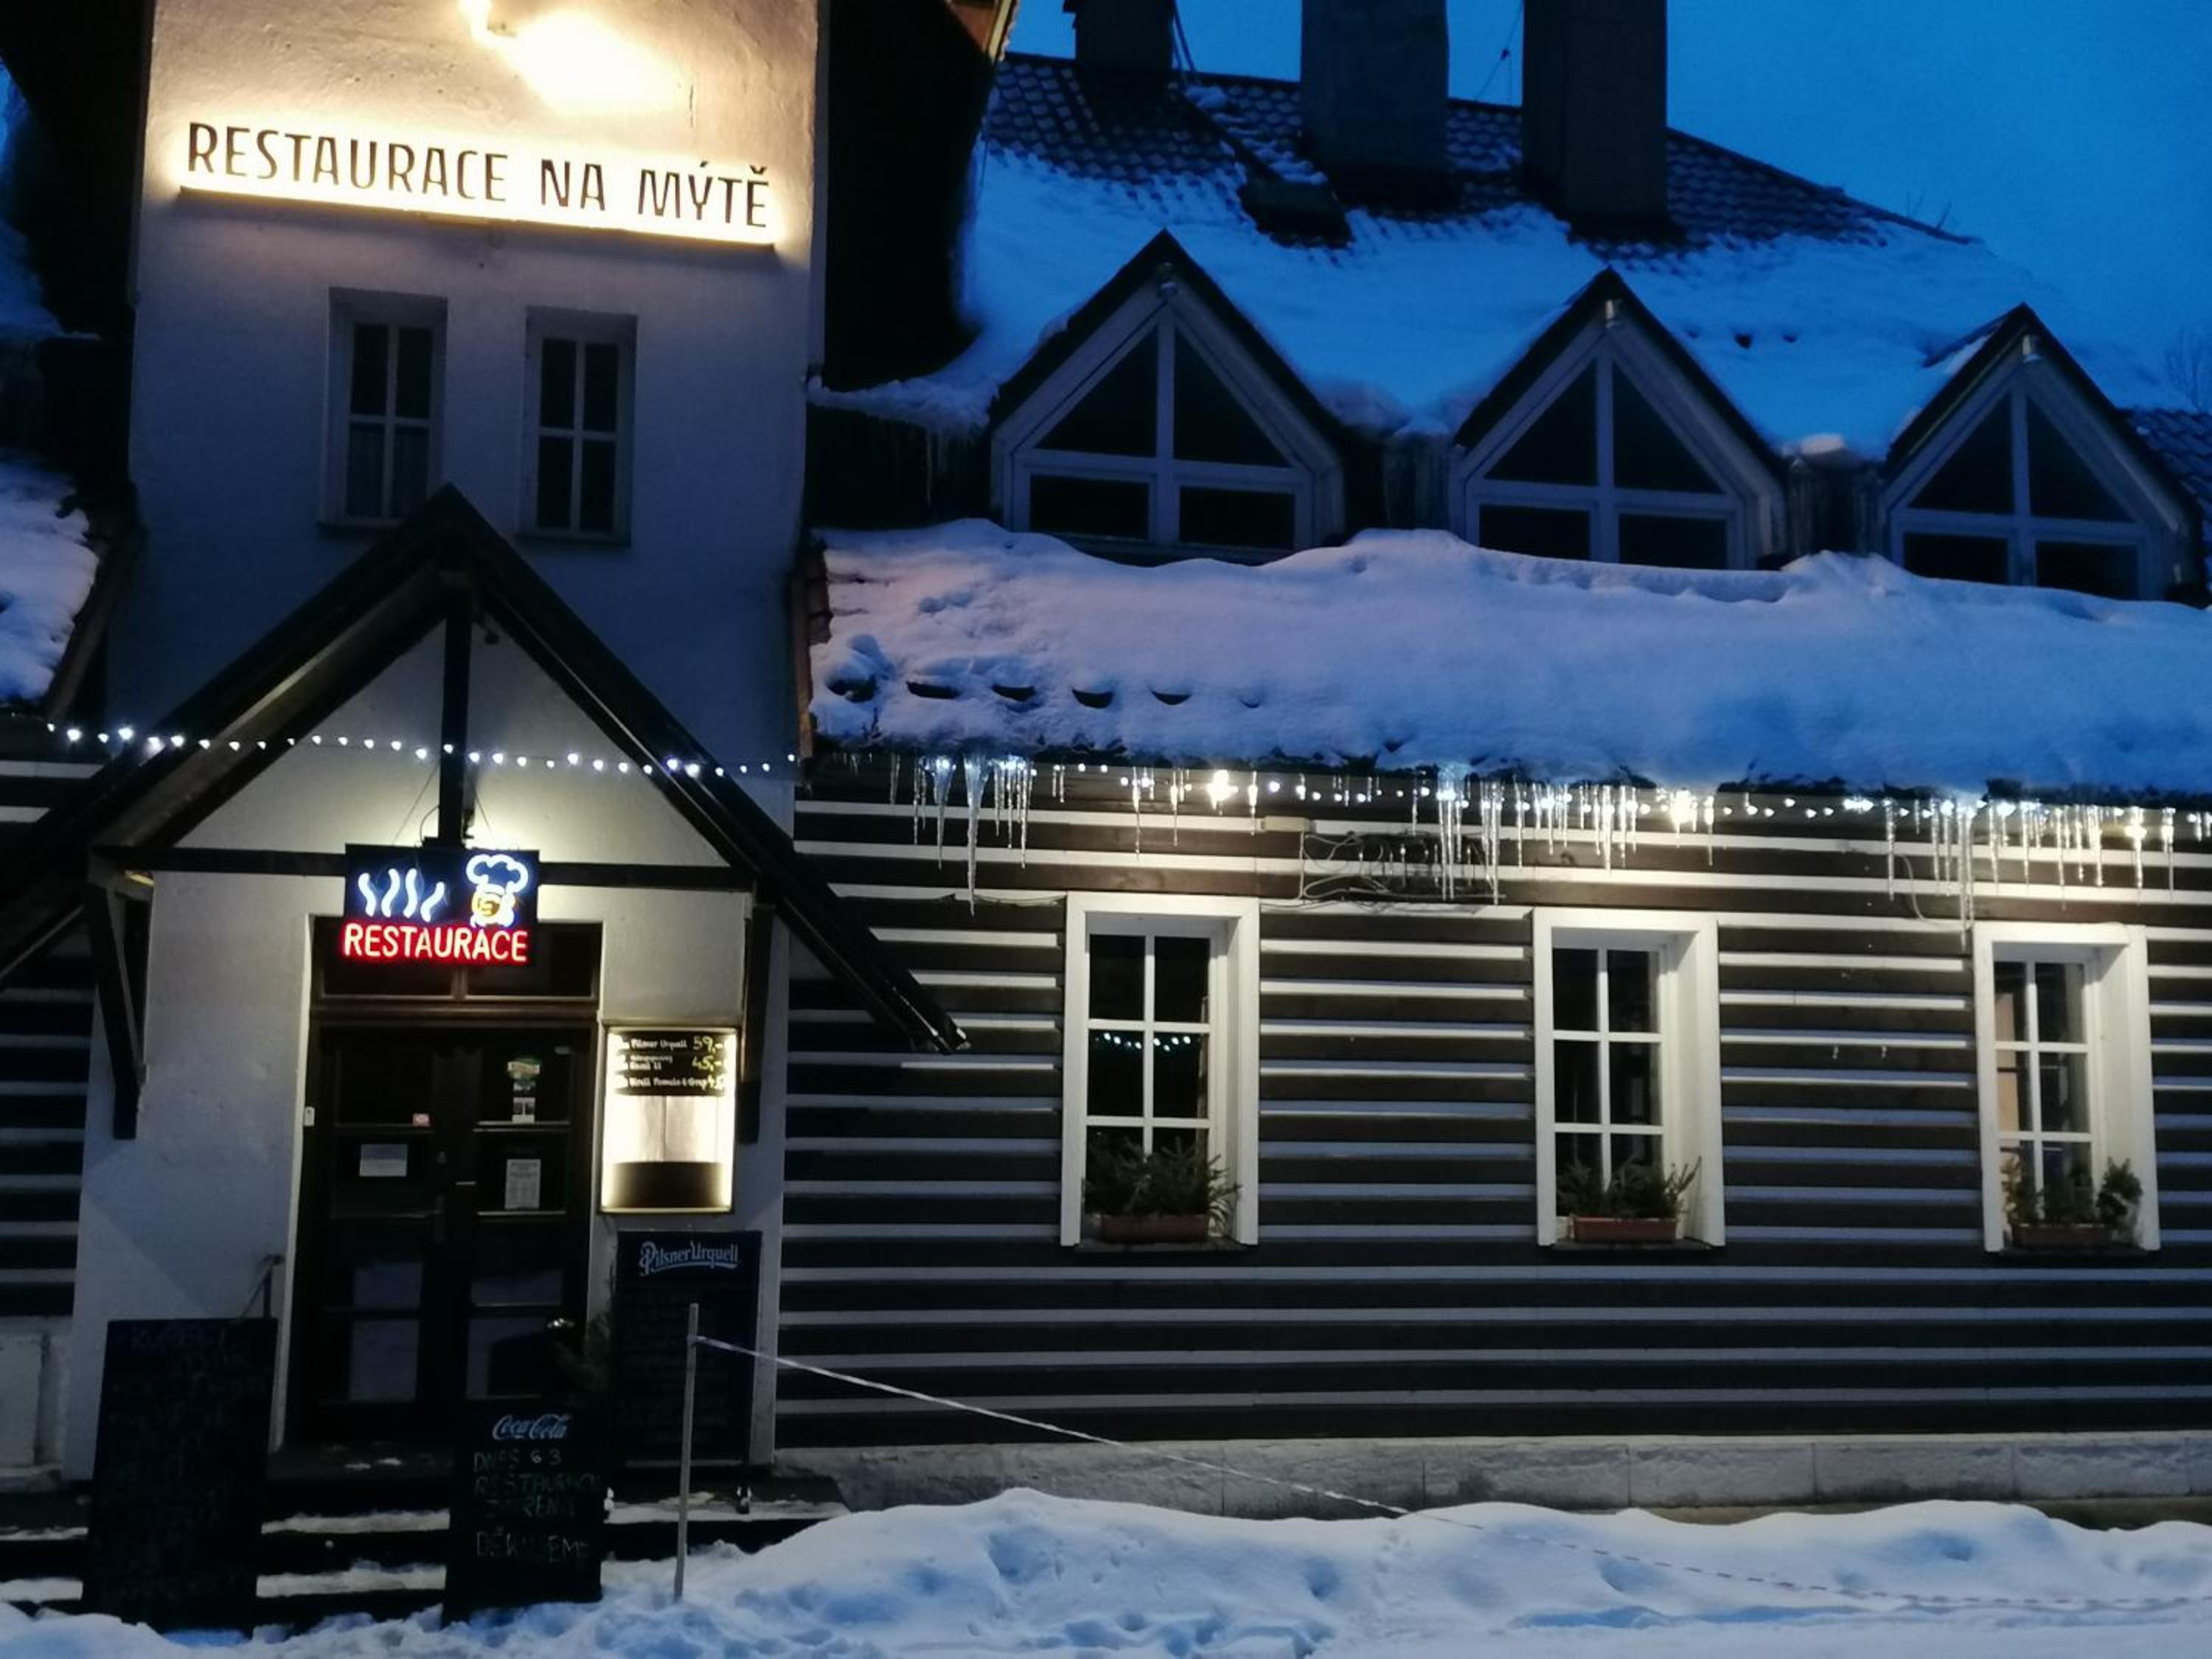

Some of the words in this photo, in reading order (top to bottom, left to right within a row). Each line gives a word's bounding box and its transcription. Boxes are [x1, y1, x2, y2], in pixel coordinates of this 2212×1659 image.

[188, 121, 508, 204] RESTAURACE
[540, 157, 607, 212] NA
[637, 159, 771, 229] MÝTĚ
[344, 922, 529, 962] RESTAURACE
[639, 1240, 691, 1276] Pilsner
[689, 1239, 740, 1269] Urquell
